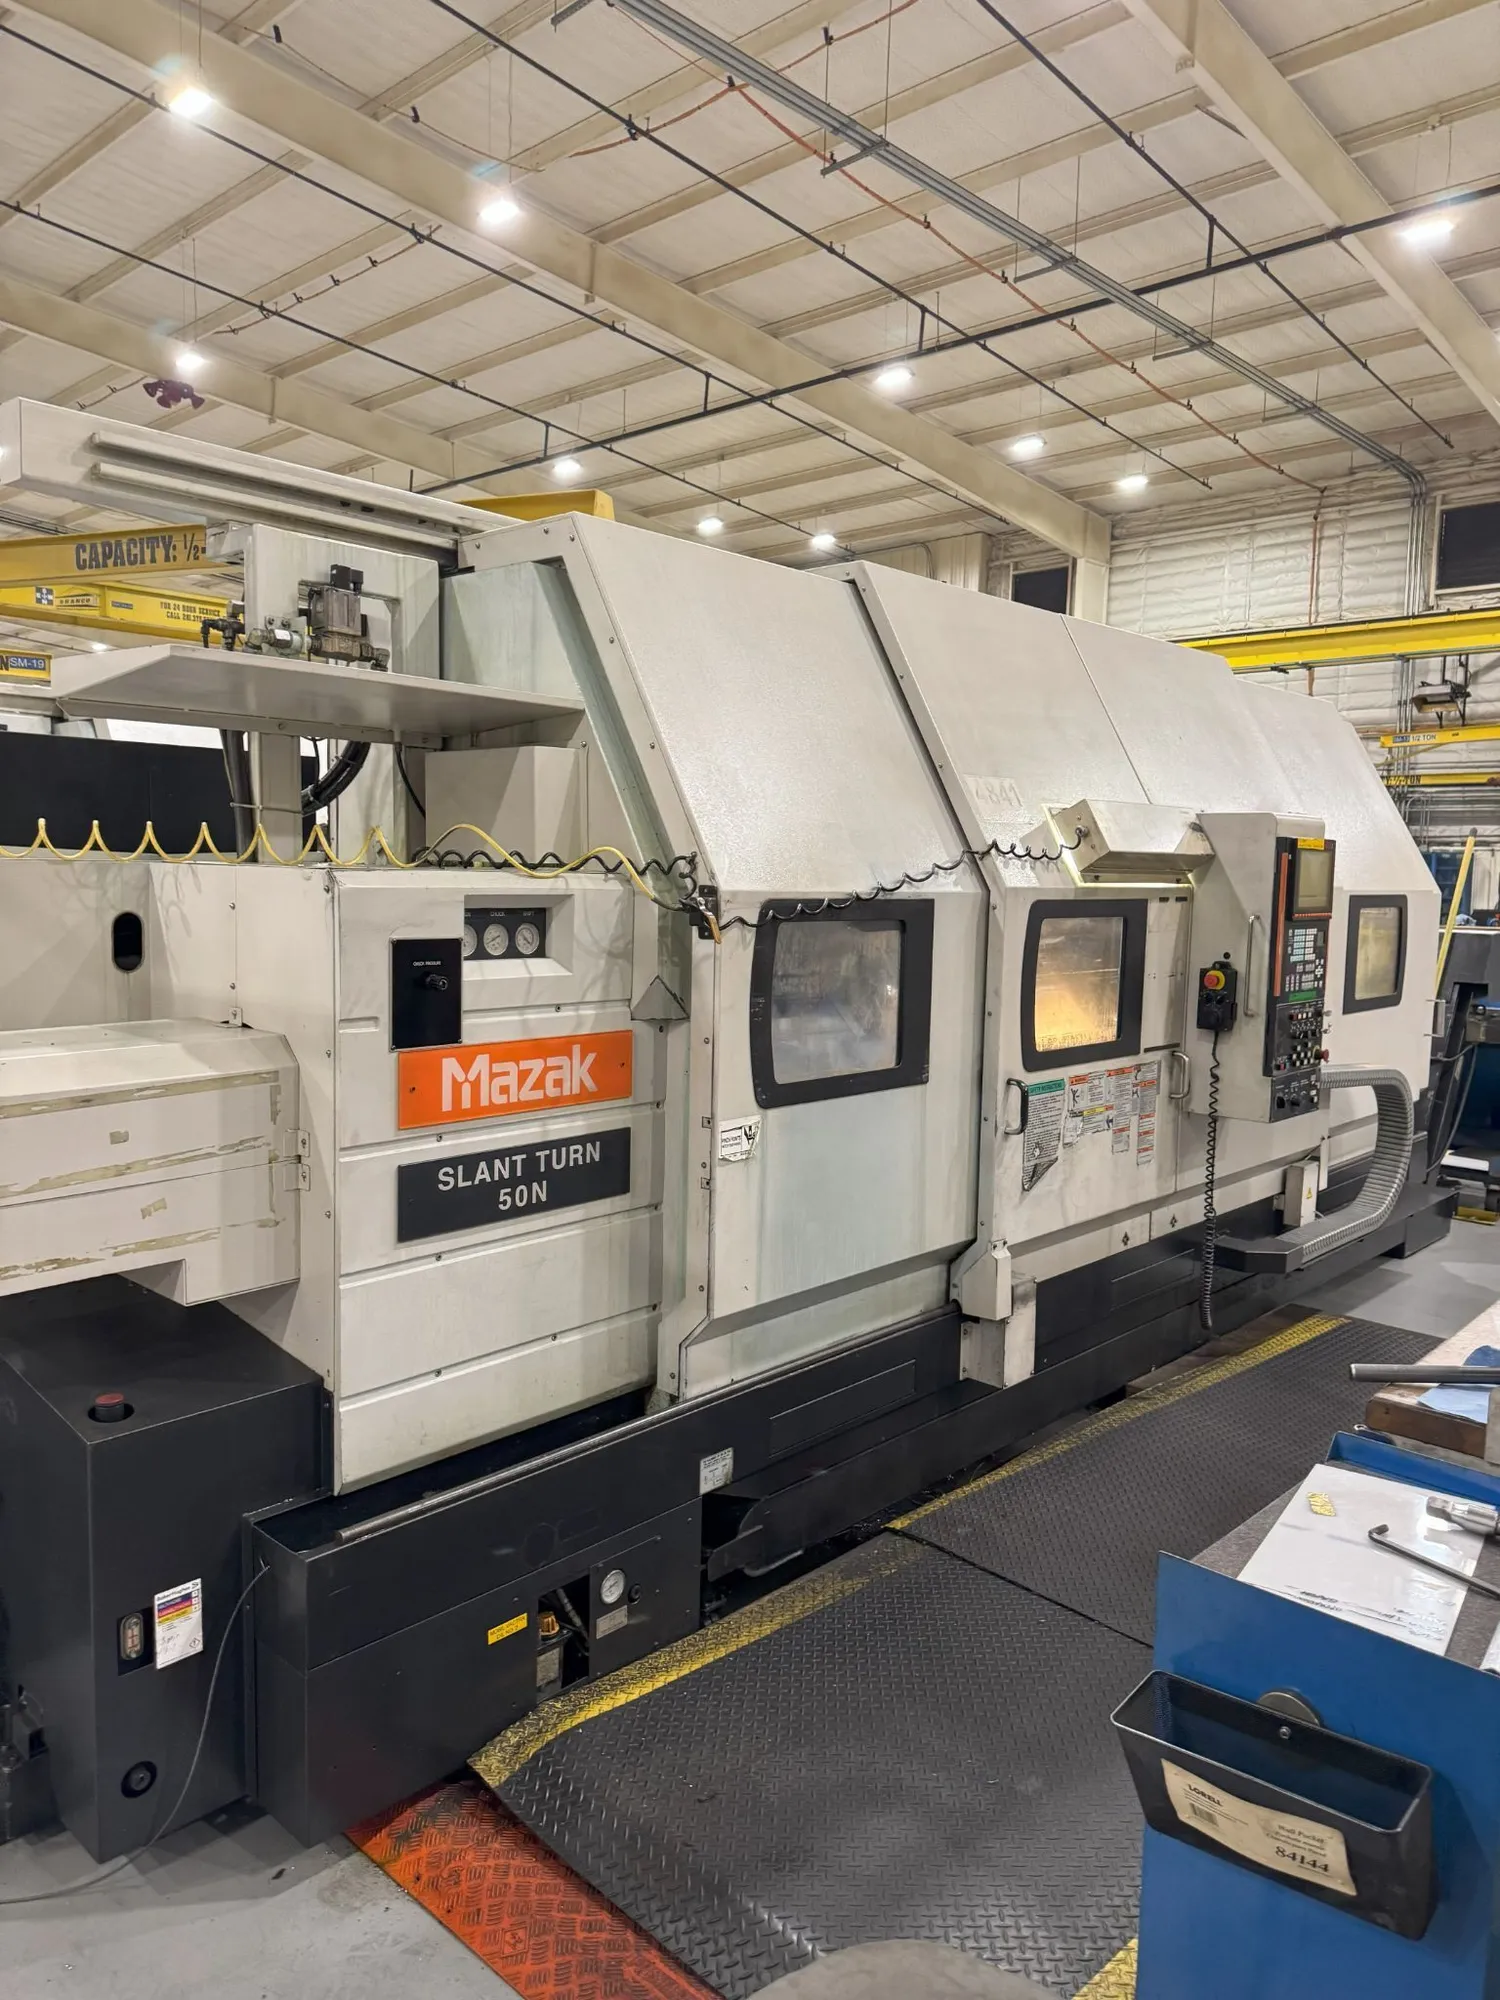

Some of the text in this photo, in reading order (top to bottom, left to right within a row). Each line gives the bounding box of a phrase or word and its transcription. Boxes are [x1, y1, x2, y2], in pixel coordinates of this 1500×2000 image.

[75, 534, 177, 570] CAPACITY:
[166, 611, 180, 619] CALL
[10, 656, 45, 670] SM-19
[1423, 733, 1437, 741] TON
[442, 1044, 598, 1111] Mazak
[437, 1141, 601, 1191] SLANT TURN
[498, 1180, 547, 1211] 50N
[1275, 1845, 1330, 1873] 84144
